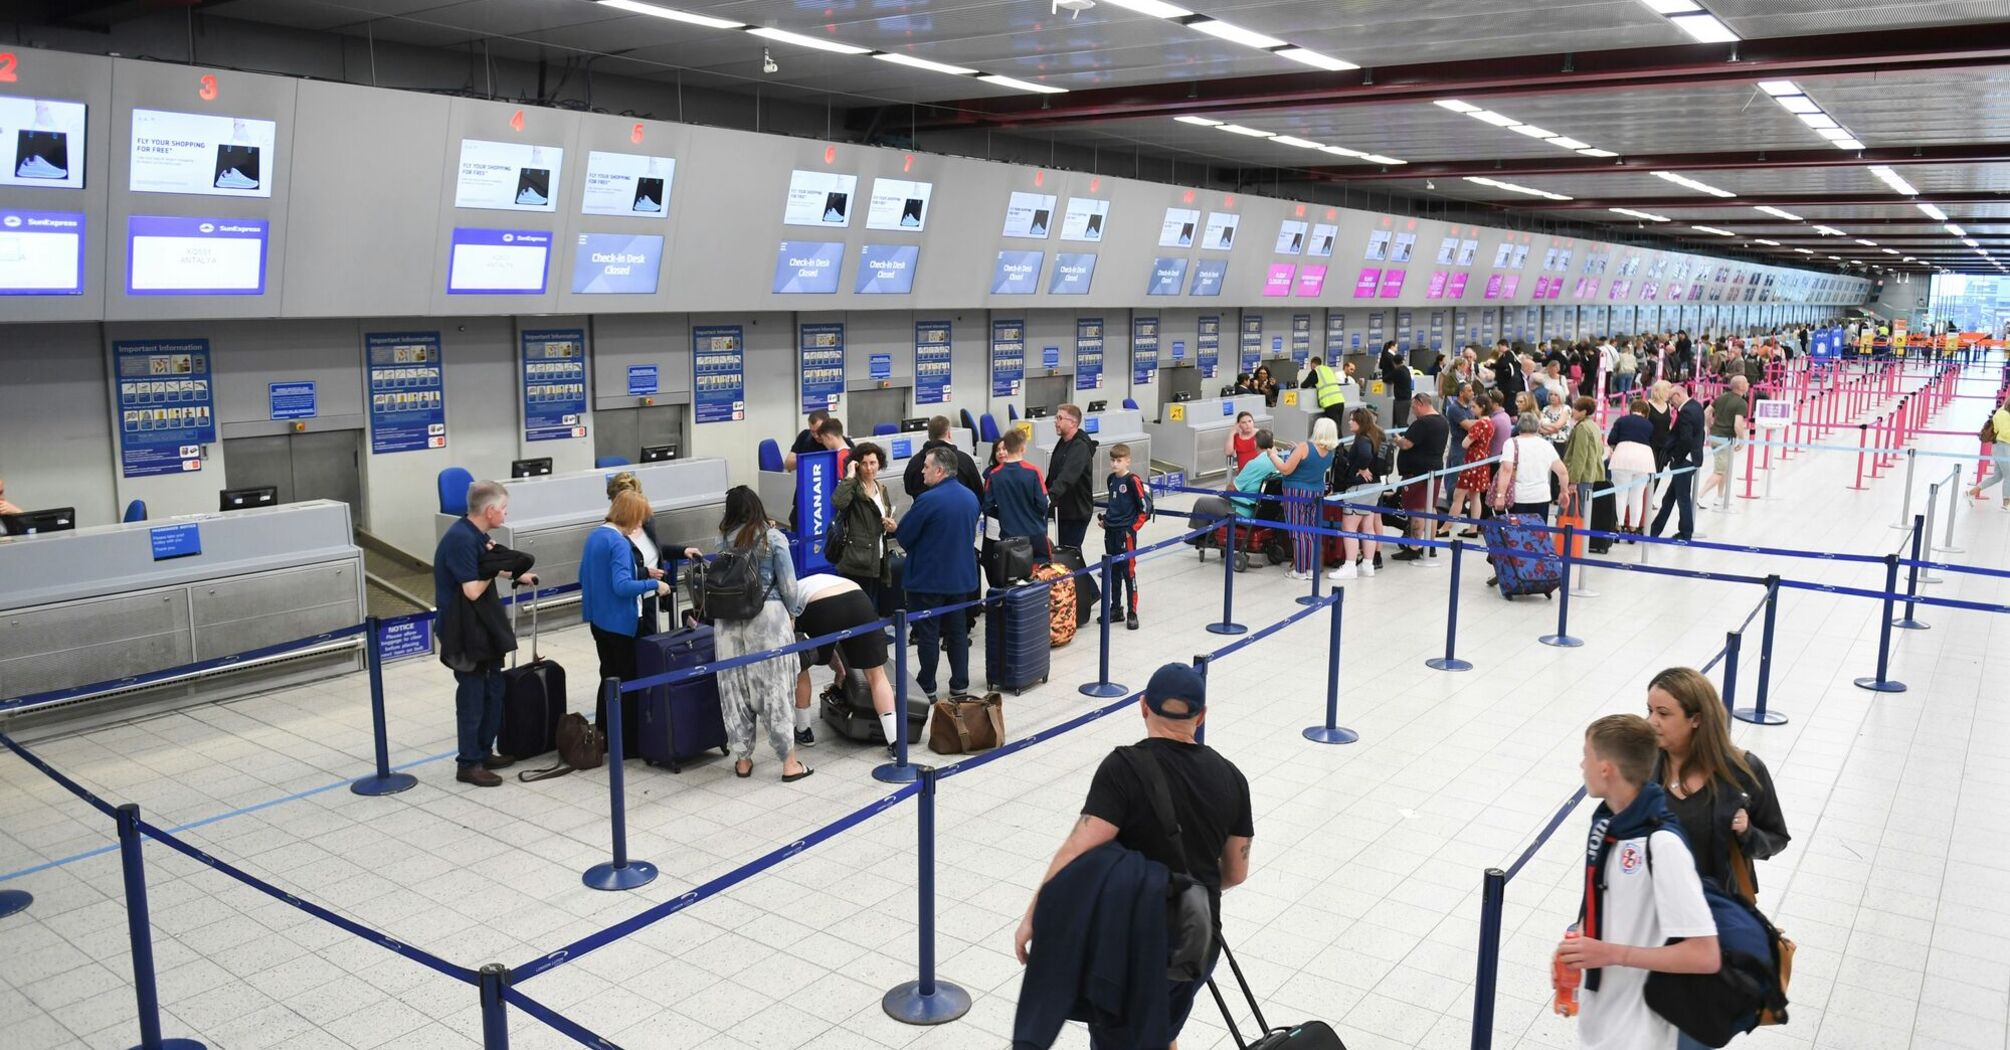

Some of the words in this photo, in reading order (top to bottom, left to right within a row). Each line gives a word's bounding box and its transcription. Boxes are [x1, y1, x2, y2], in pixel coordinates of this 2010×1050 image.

[0, 53, 17, 83] 2
[200, 75, 218, 100] 3
[510, 110, 526, 132] 4
[631, 123, 644, 144] 5
[172, 140, 205, 148] SHOPPING
[904, 154, 914, 172] 7
[28, 218, 77, 228] SunExpress
[220, 225, 261, 233] SunExpress
[592, 252, 625, 263] Check-in
[627, 254, 645, 264] Desk
[790, 258, 815, 267] Check-in
[604, 265, 630, 275] Closed
[388, 623, 415, 633] NOTICE
